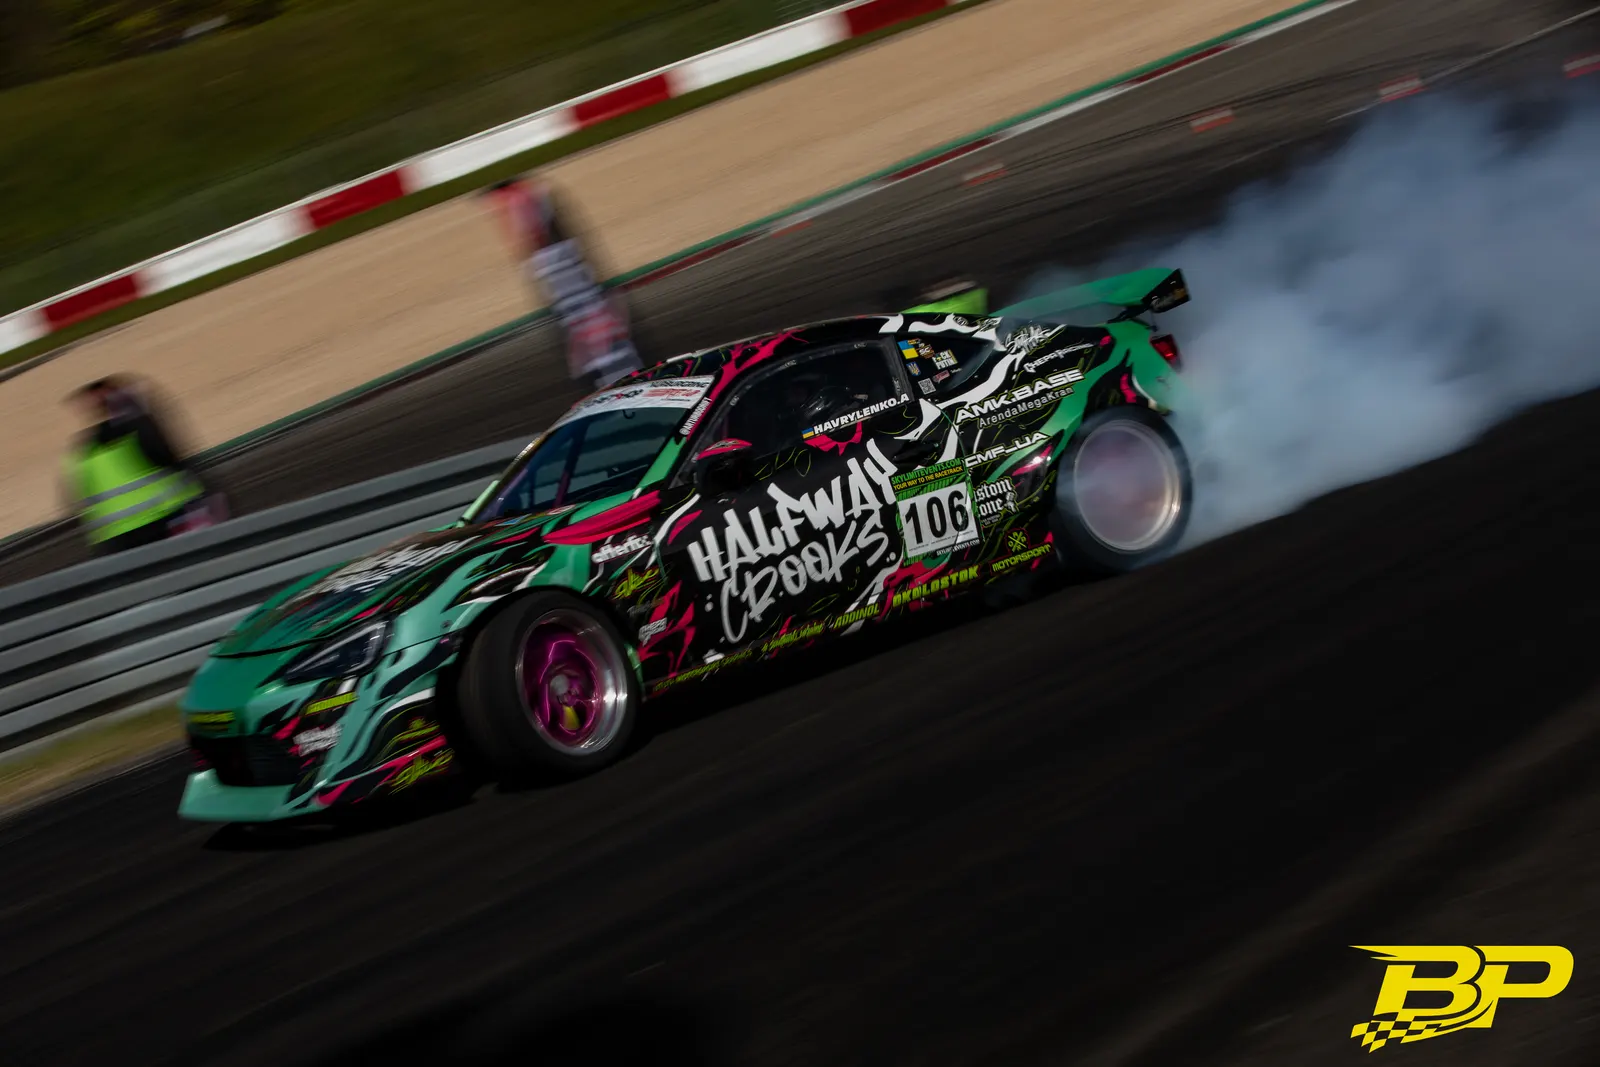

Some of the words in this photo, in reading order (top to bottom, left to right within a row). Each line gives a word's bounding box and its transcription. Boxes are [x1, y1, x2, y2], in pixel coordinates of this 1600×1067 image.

[813, 393, 910, 434] HAVRYLENKO.A
[956, 369, 1085, 423] AMK.BASE
[979, 387, 1074, 428] ArendaMegaKran
[891, 457, 963, 485] SKYLIMITEVENTS.COM
[893, 482, 907, 491] YOUR
[935, 465, 963, 479] RACETRACK
[687, 438, 898, 584] HALFWAY
[905, 490, 969, 545] 106
[720, 512, 889, 644] CROOKS
[992, 544, 1051, 572] MOTORSPORT
[833, 603, 880, 630] ADDINOL
